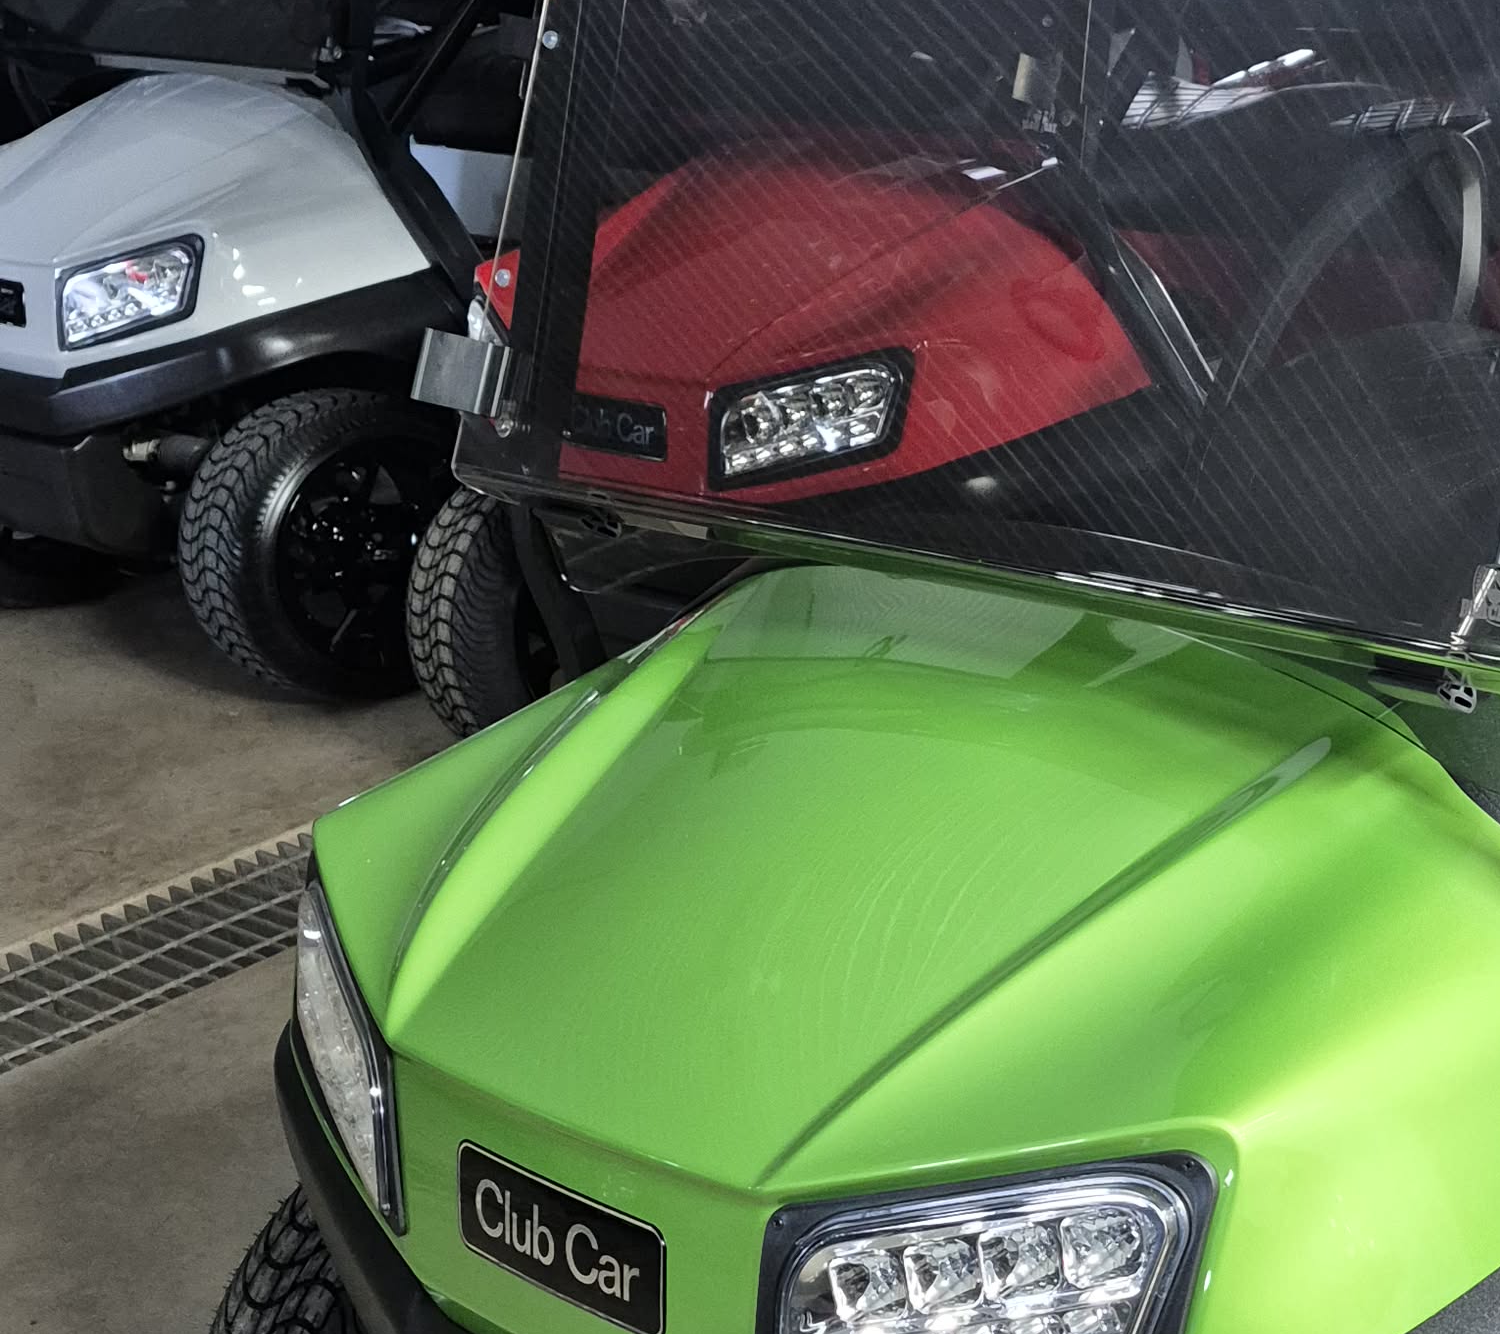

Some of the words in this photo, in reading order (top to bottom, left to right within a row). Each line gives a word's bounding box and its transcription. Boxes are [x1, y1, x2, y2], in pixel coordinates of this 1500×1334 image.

[616, 412, 655, 445] Car
[475, 1178, 555, 1267] Club
[565, 1223, 640, 1302] Car
